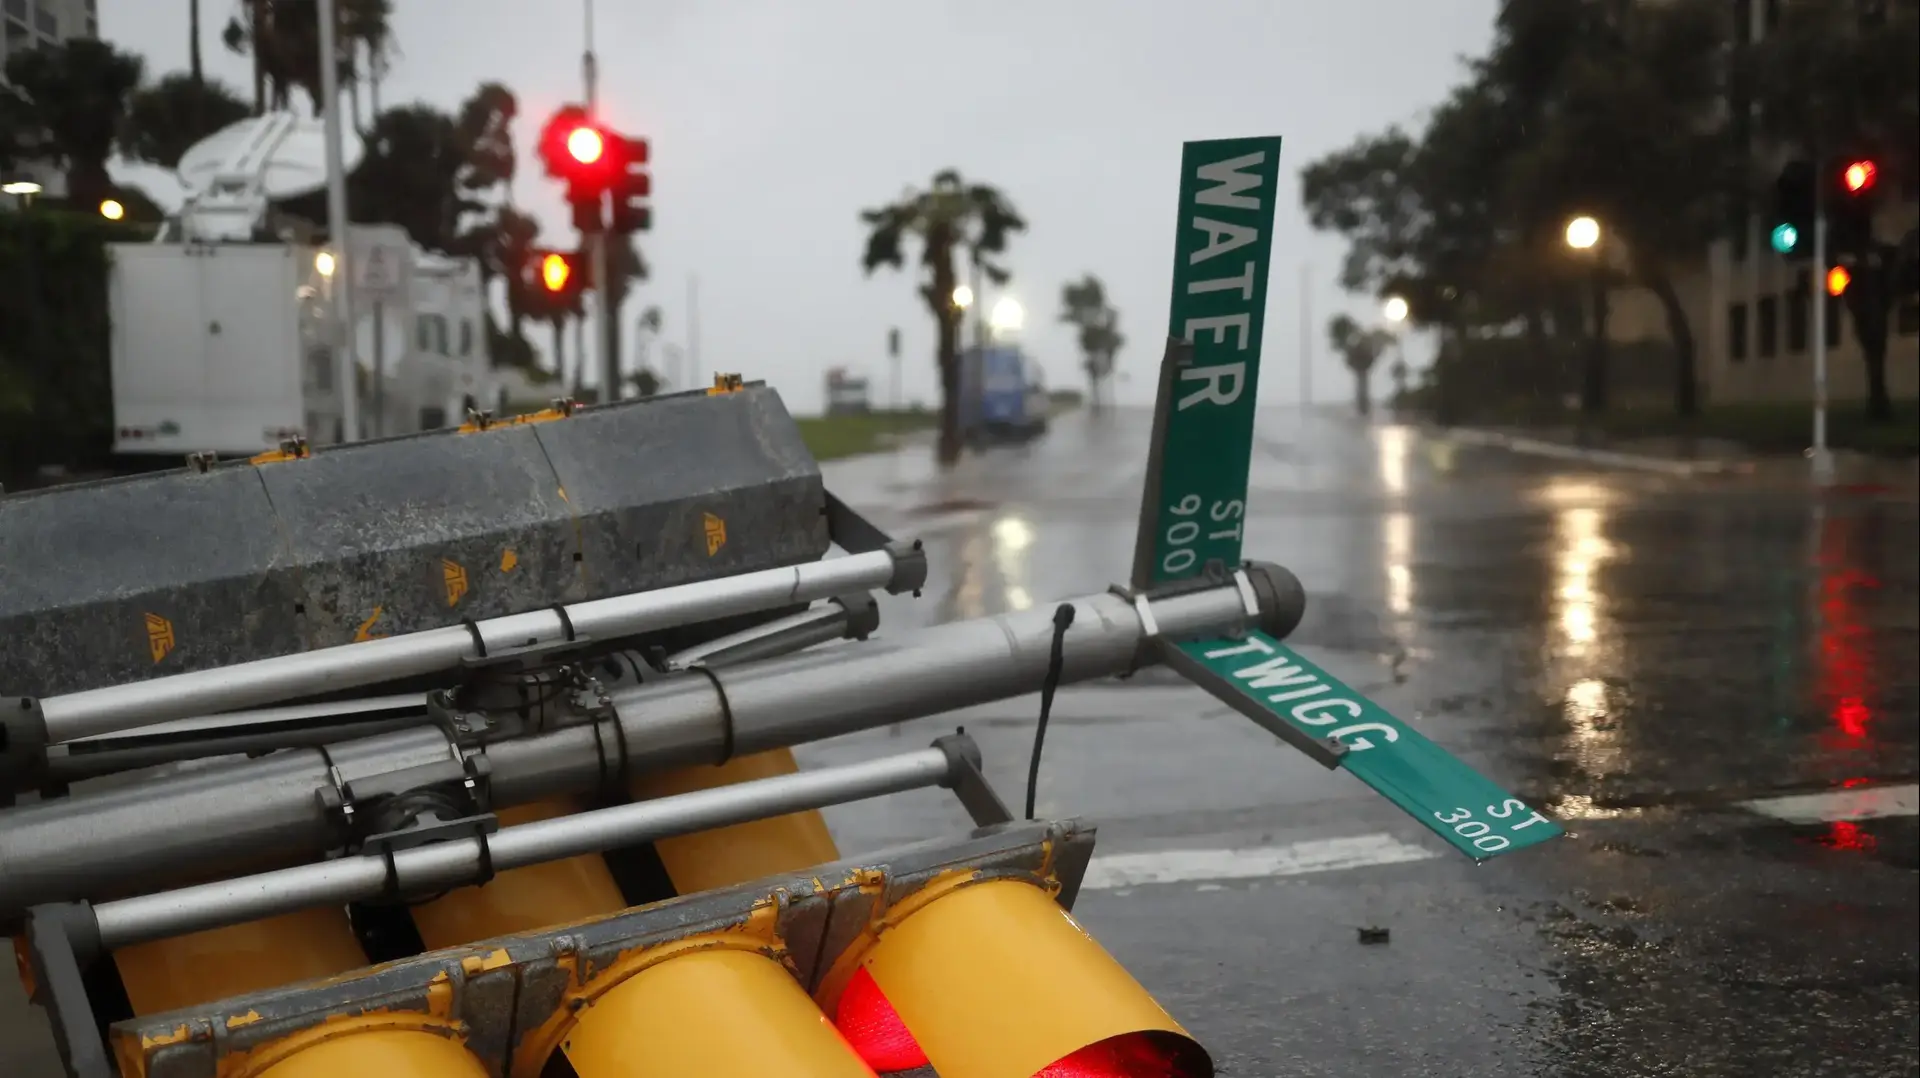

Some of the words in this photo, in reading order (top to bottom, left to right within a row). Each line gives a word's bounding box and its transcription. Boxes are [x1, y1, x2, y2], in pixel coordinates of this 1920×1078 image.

[1178, 151, 1265, 411] WATER
[1163, 494, 1200, 573] 900
[1209, 499, 1242, 541] ST
[1204, 636, 1398, 751] TWIGG
[1434, 807, 1510, 852] 300
[1487, 798, 1549, 831] ST
